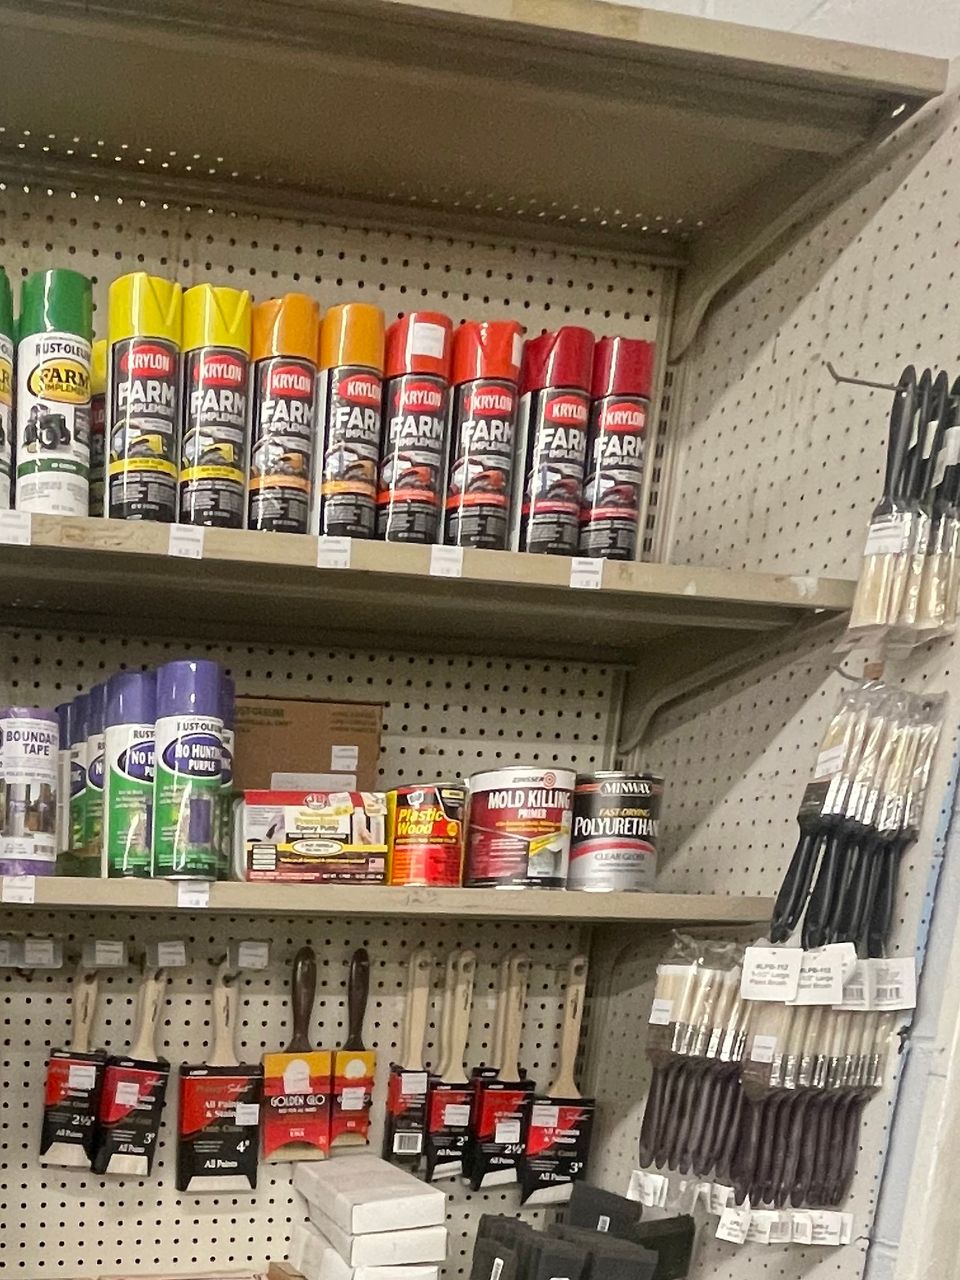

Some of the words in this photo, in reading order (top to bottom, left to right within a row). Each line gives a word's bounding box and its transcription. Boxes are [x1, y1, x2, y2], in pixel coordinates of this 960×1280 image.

[36, 343, 89, 361] RUST-OLEU
[41, 368, 89, 389] FARM
[118, 379, 175, 408] FARM
[191, 388, 245, 415] FARM
[261, 400, 313, 424] FARM
[391, 415, 444, 440] FARM
[462, 419, 513, 444] FARM
[594, 435, 645, 458] FARM
[6, 731, 57, 745] BOUNDA
[22, 743, 50, 756] TAPE
[189, 759, 215, 771] PURPLE
[604, 783, 651, 795] MINWAX
[488, 792, 524, 809] MOLD
[528, 790, 571, 808] KILLING
[398, 808, 444, 821] Plastic
[517, 809, 547, 819] PRIMER
[599, 807, 650, 818] FAST-DRYING
[397, 821, 432, 834] Wood
[271, 1096, 304, 1108] GOLDEN
[307, 1094, 326, 1105] GLO
[204, 1160, 217, 1169] All
[539, 1173, 551, 1181] All
